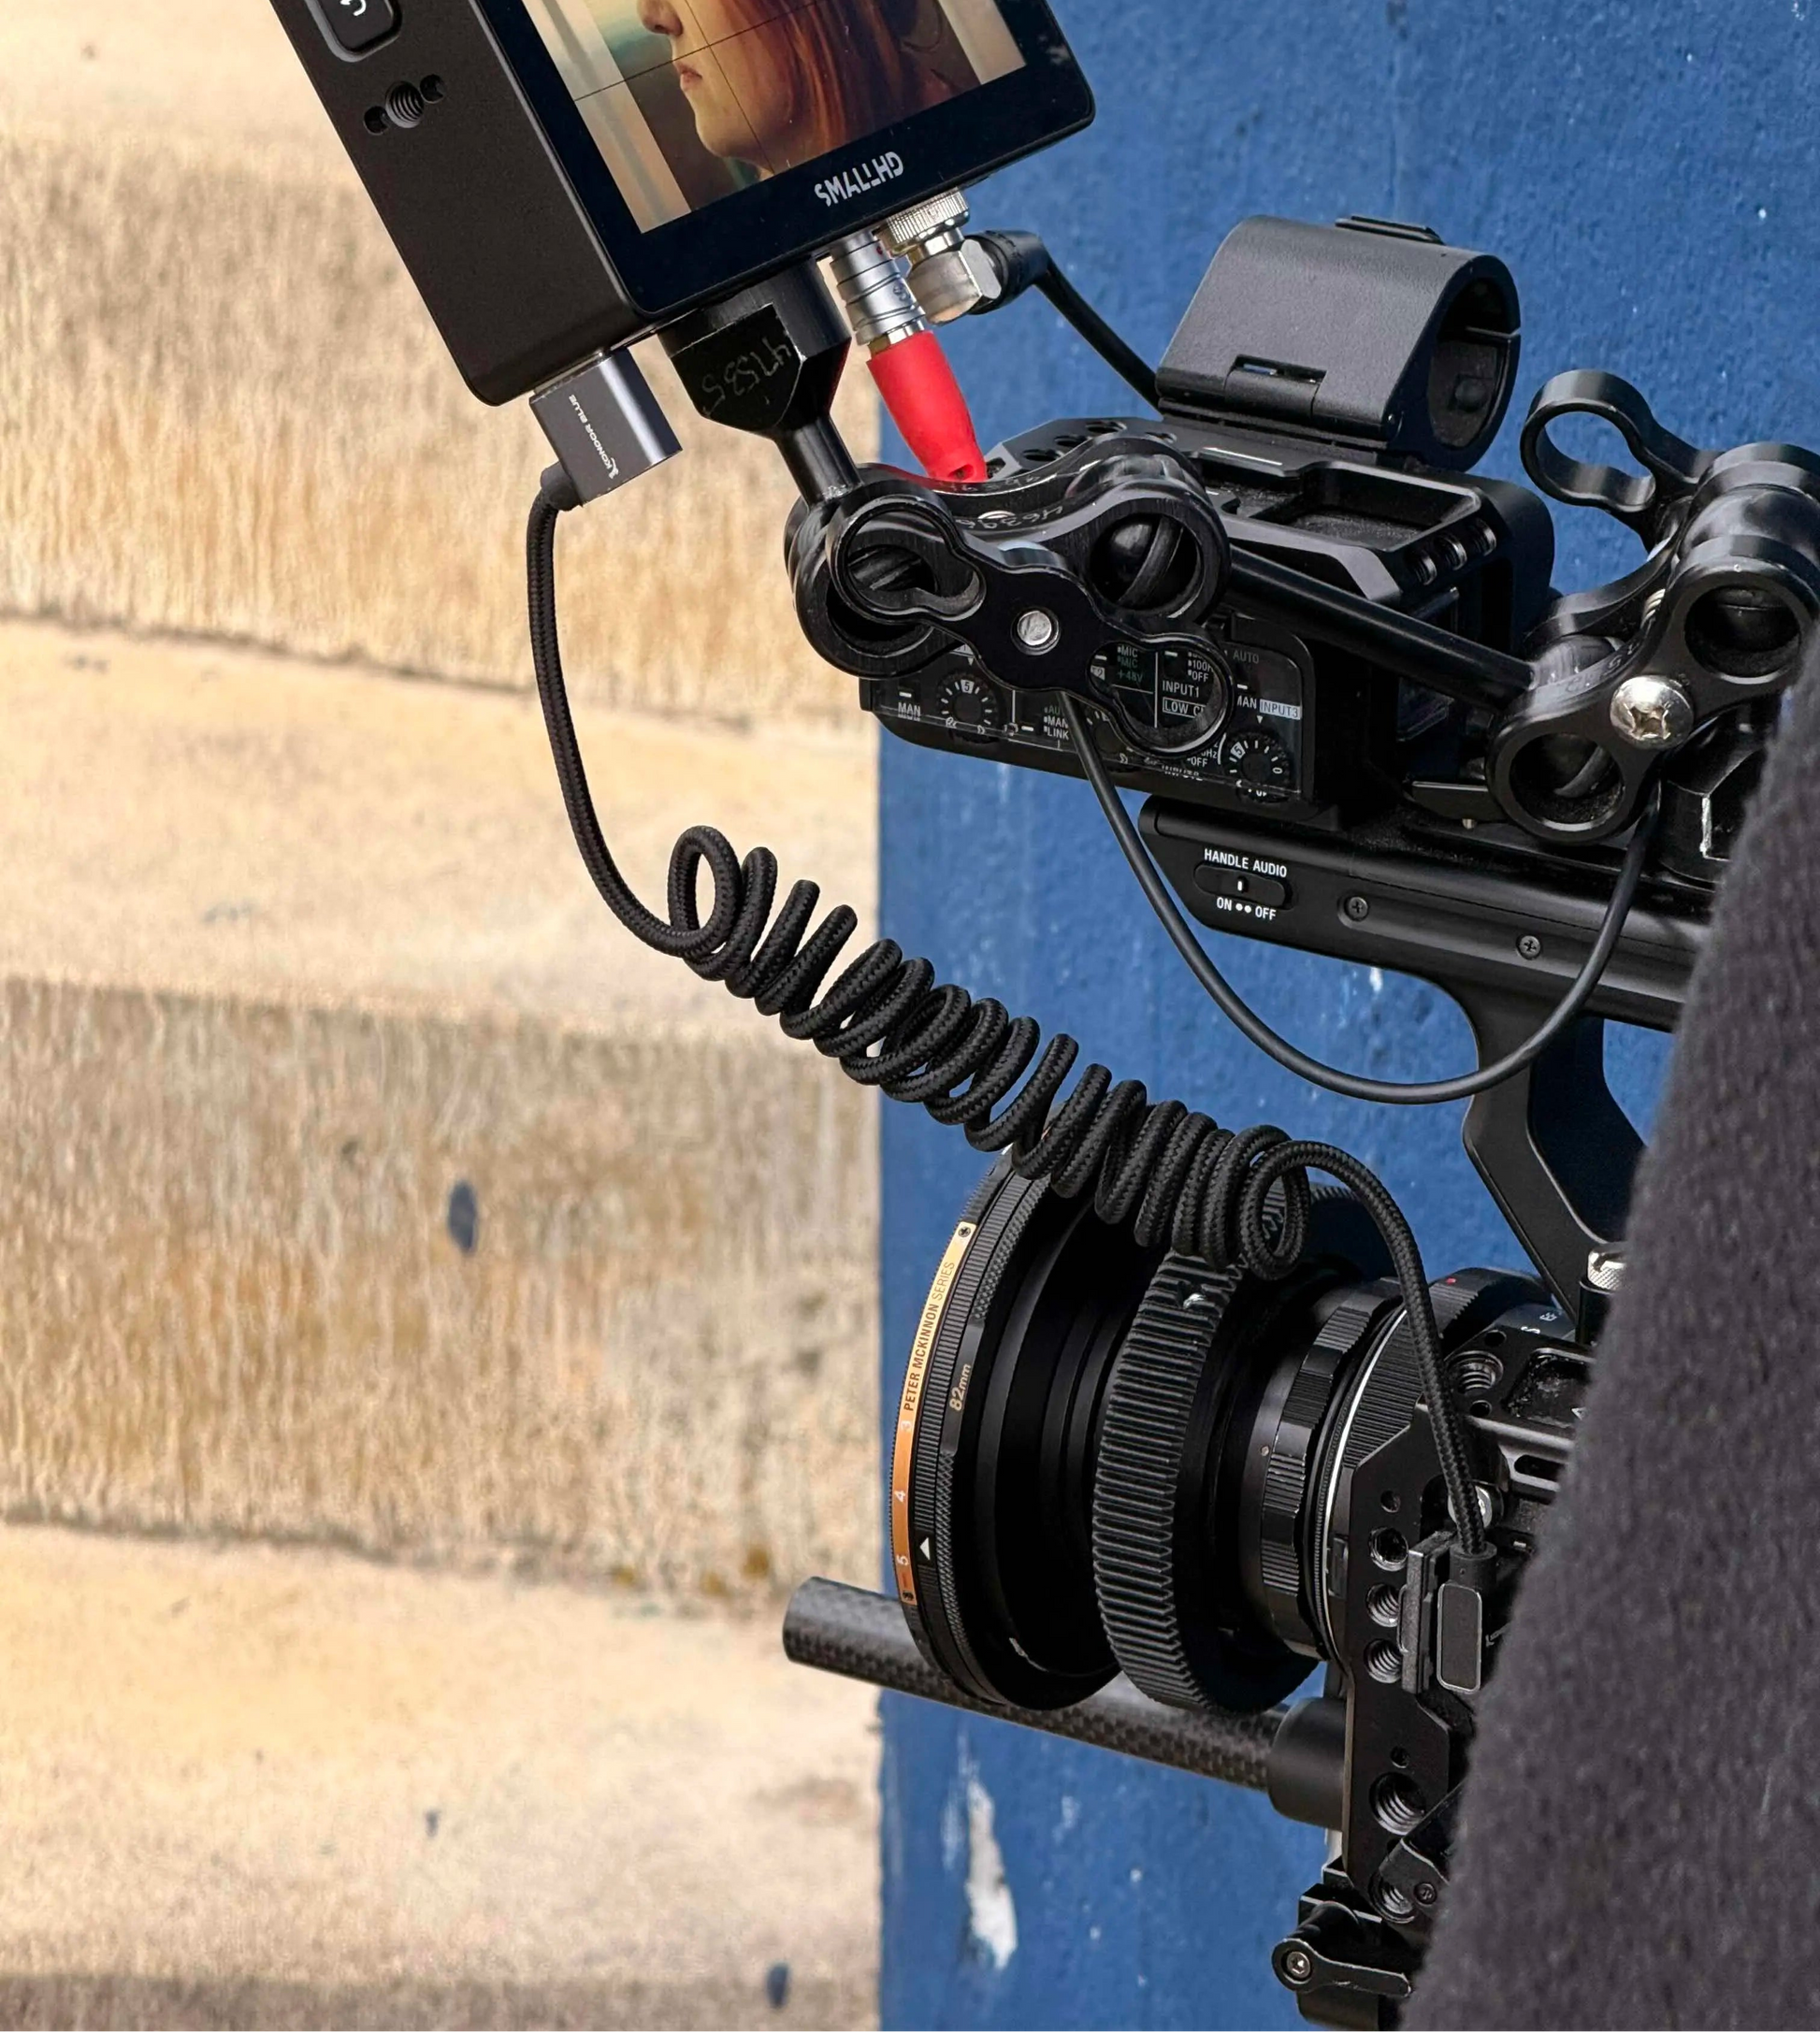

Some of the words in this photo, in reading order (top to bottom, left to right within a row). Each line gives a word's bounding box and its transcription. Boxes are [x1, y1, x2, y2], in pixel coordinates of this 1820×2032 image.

[814, 151, 903, 207] SMALLHD
[568, 394, 588, 424] BLUE
[585, 424, 613, 469] KONDOR
[1121, 643, 1138, 658] MIC
[1233, 650, 1260, 664] AUTO
[1192, 670, 1209, 683] OFF
[1163, 680, 1199, 699] INPUT1
[898, 701, 921, 718] MAN
[1164, 699, 1189, 714] LOW
[1260, 700, 1299, 719] INPUT3
[1047, 727, 1070, 741] LINK
[1191, 756, 1208, 768] OFF
[1204, 848, 1249, 870] HANDLE
[1253, 859, 1288, 878] AUDIO
[1217, 897, 1232, 912] ON
[1255, 905, 1277, 920] OFF
[903, 1372, 921, 1411] PETER
[912, 1304, 940, 1370] MCKINNON
[932, 1261, 956, 1301] SERIES
[948, 1363, 972, 1412] 82mm
[894, 1489, 906, 1504] 4
[896, 1554, 910, 1567] 5
